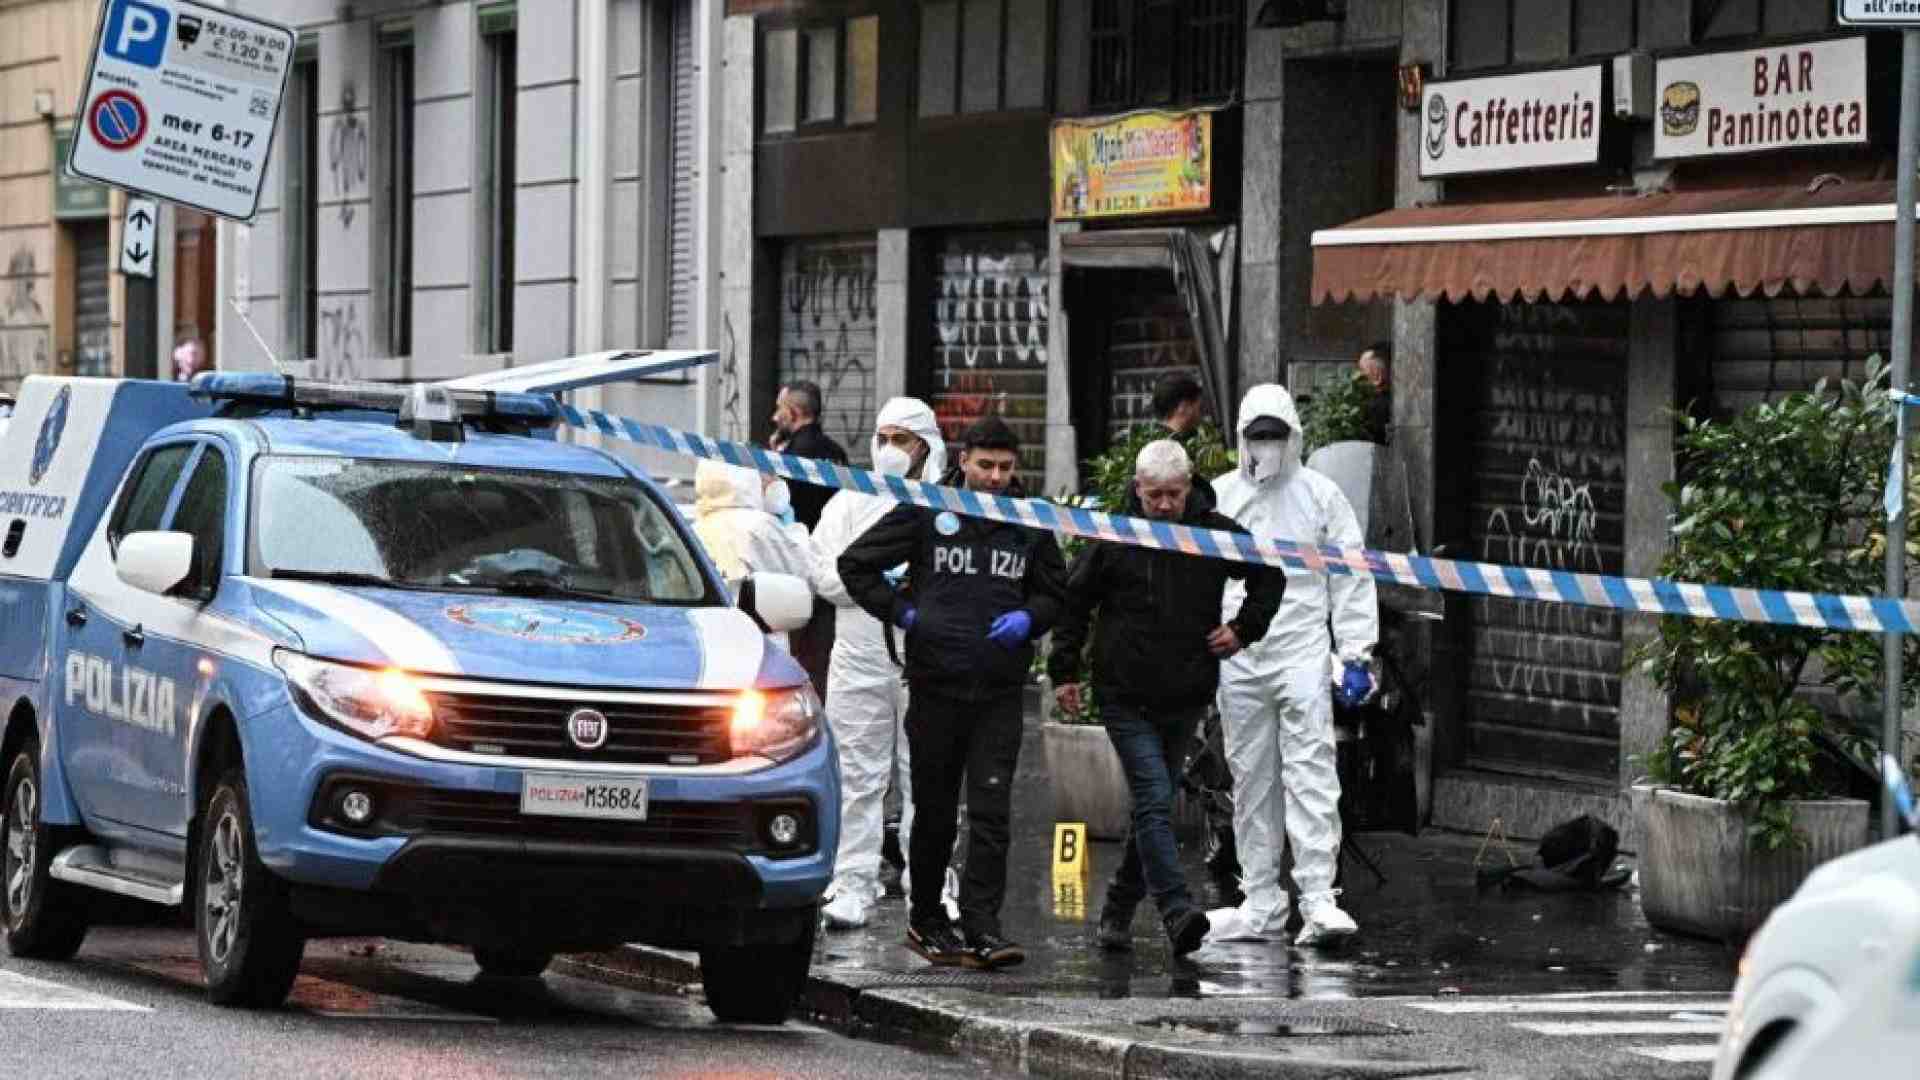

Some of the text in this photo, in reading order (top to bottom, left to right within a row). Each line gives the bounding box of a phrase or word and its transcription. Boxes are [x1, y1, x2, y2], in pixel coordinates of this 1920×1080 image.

[116, 8, 157, 54] P
[1753, 51, 1813, 97] BAR
[162, 113, 255, 149] mer 6-17
[1455, 92, 1594, 148] Caffetteria
[1707, 101, 1861, 148] Paninoteca
[153, 136, 252, 172] AREA MERCATO
[66, 650, 176, 736] POLIZIA
[577, 719, 600, 737] FIAT
[529, 785, 641, 810] POLIZIA M3684
[1061, 829, 1076, 862] B
